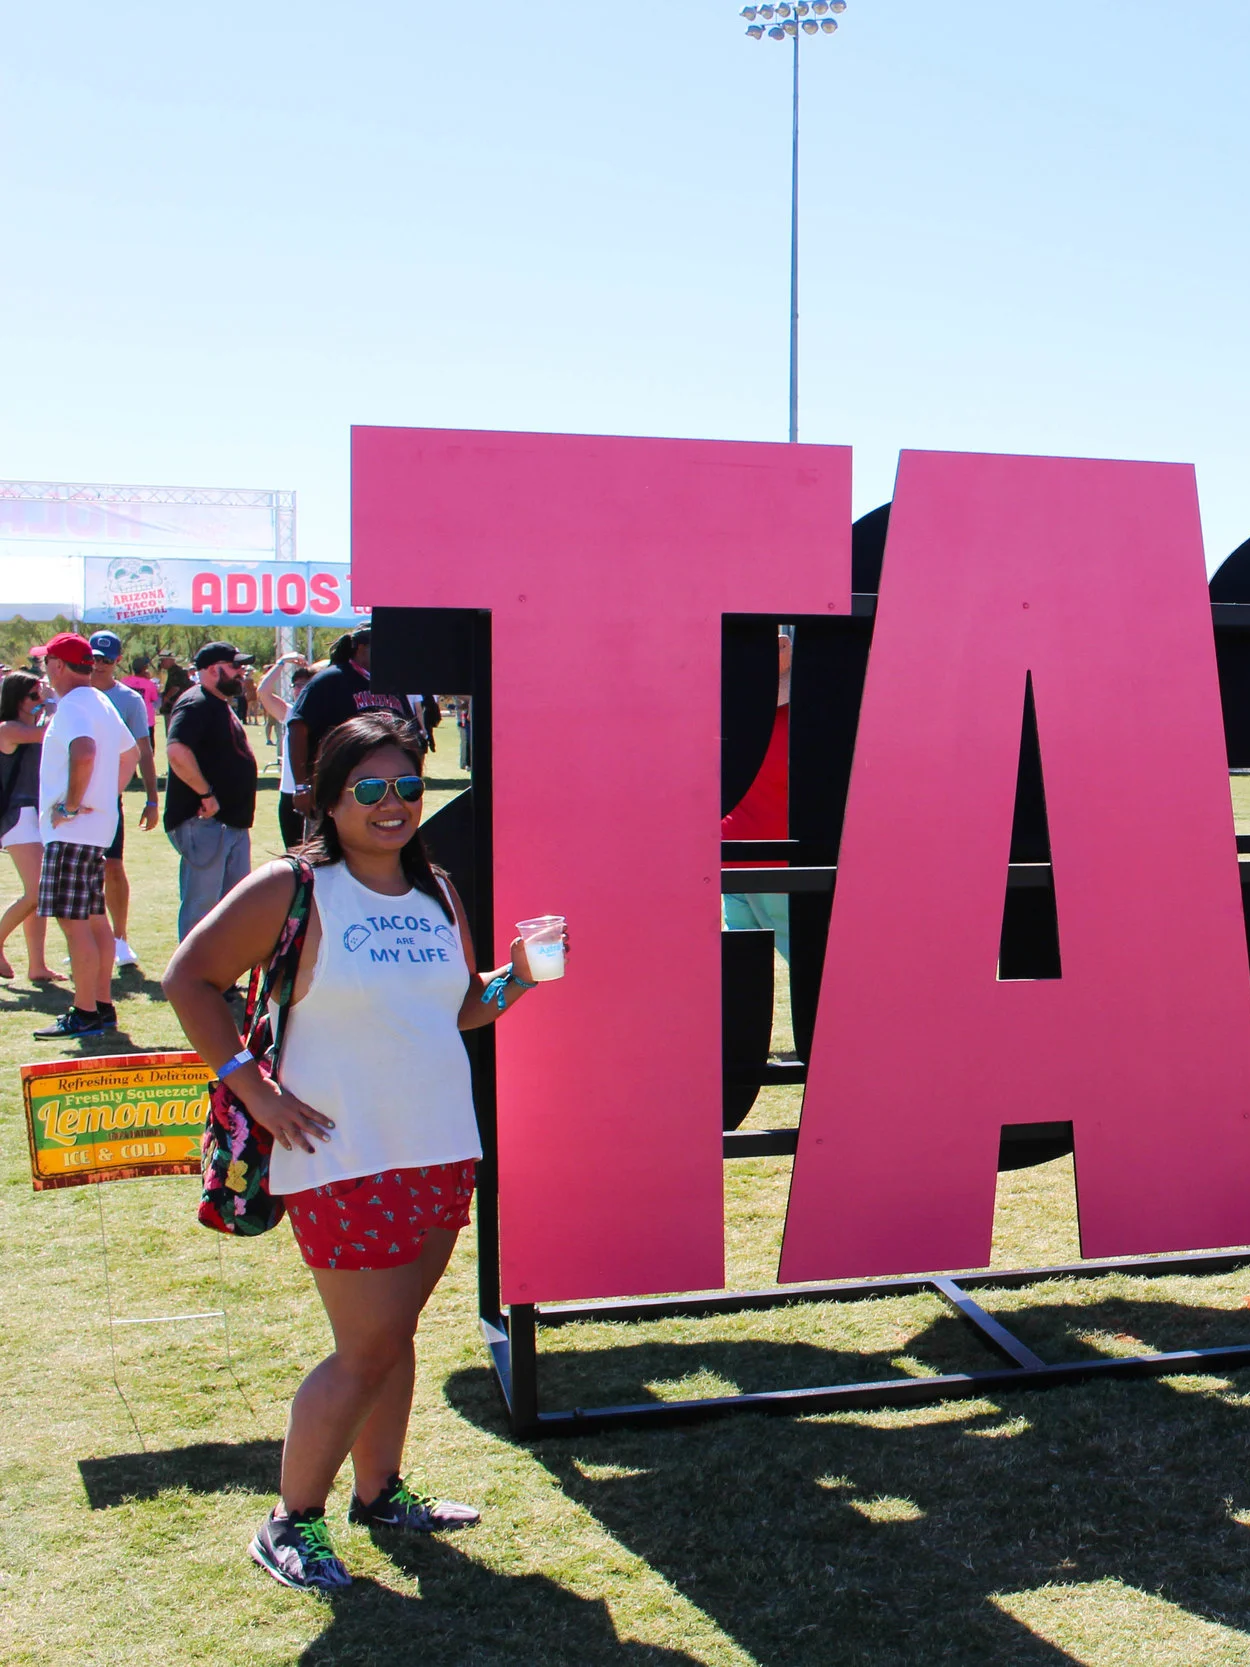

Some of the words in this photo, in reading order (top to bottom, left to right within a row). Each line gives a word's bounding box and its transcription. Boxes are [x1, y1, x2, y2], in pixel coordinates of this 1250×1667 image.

[113, 588, 165, 605] ARIZONA
[191, 572, 341, 615] ADIOS
[116, 605, 168, 620] FESTIVAL
[125, 600, 157, 610] TACO
[366, 916, 431, 932] TACOS
[396, 937, 415, 945] ARE
[370, 948, 400, 963] MY
[407, 948, 450, 963] LIFE
[58, 1074, 129, 1092] Refreshing
[133, 1072, 145, 1083] &
[150, 1069, 209, 1083] Delicious
[64, 1089, 124, 1106] Freshly
[126, 1085, 198, 1100] Squeezed
[38, 1091, 210, 1146] Lemonad
[63, 1150, 91, 1168] ICE
[98, 1148, 114, 1162] &
[120, 1142, 167, 1159] COLD
